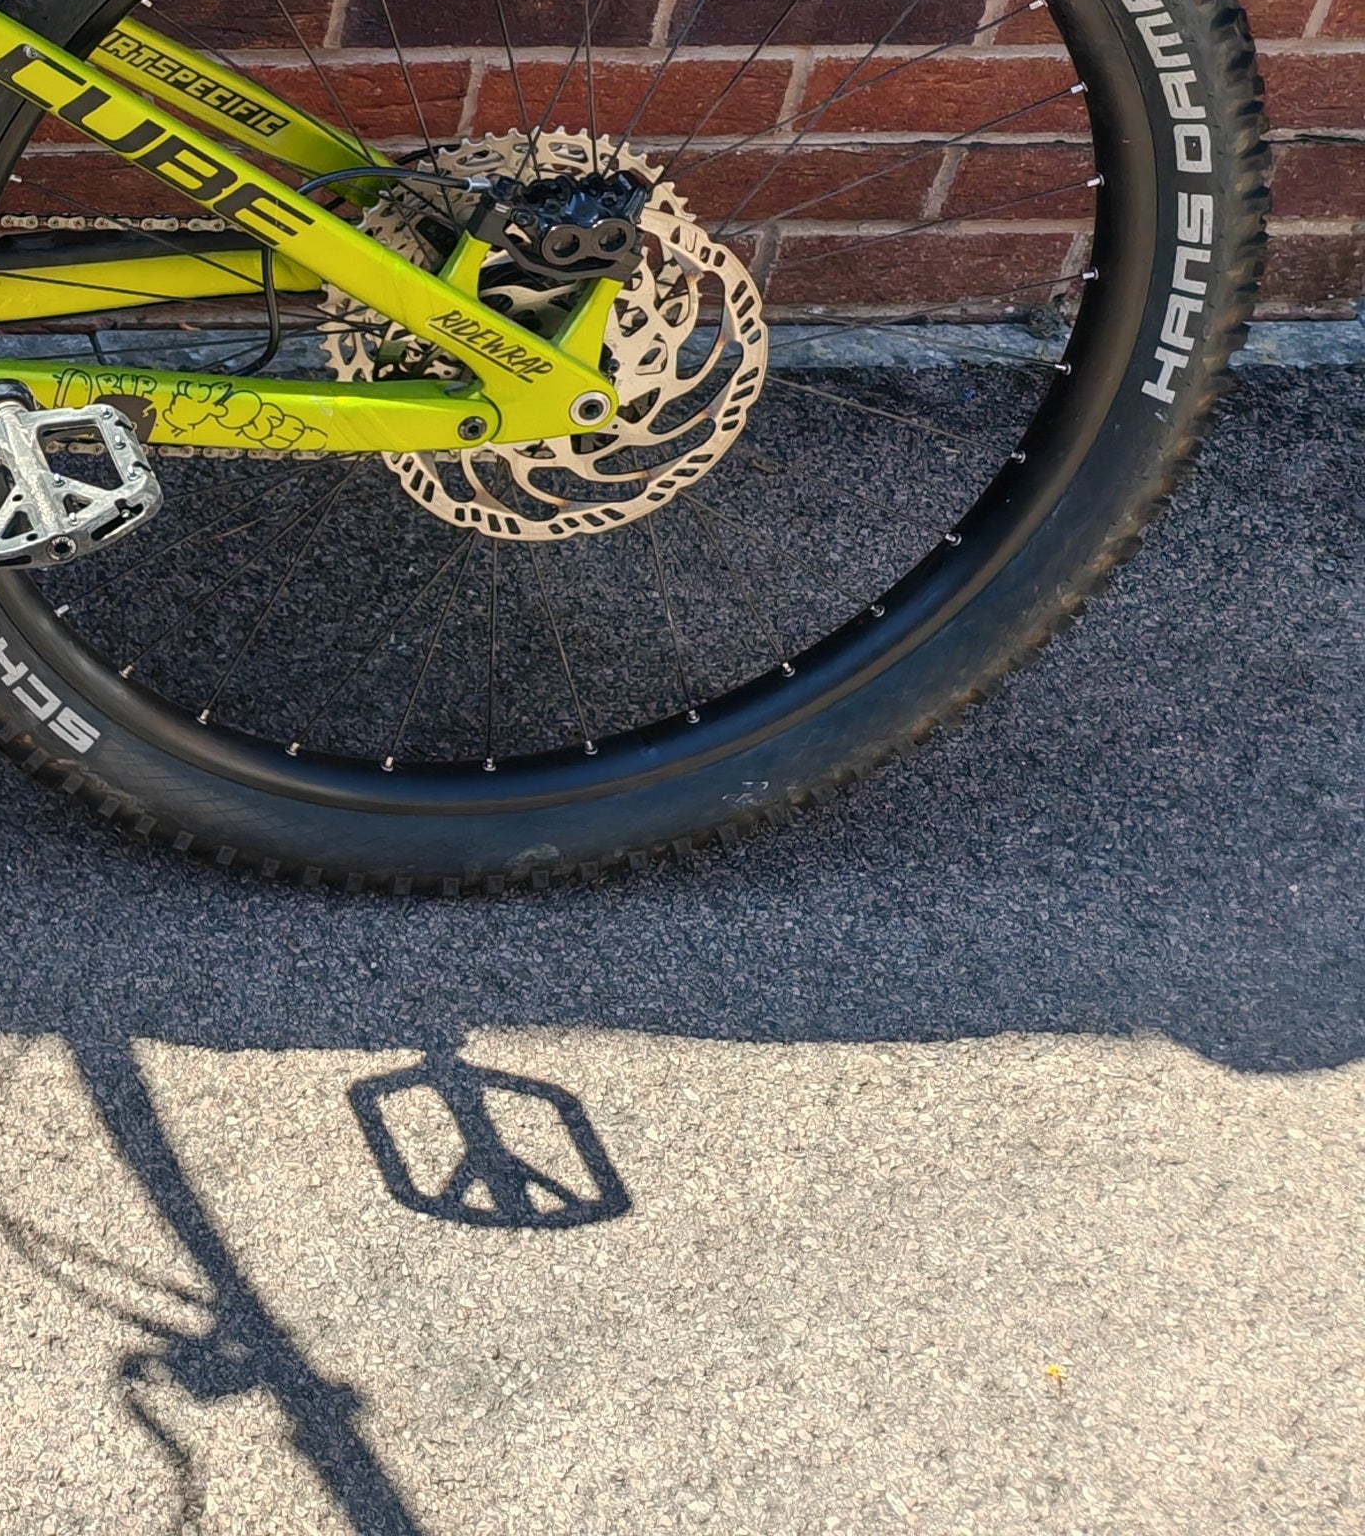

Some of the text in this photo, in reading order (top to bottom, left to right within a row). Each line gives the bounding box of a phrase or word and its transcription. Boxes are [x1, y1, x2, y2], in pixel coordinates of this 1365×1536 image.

[98, 29, 290, 137] IRTSPECIFIC
[429, 309, 554, 378] RIDEWRAP
[1141, 192, 1214, 404] HANS
